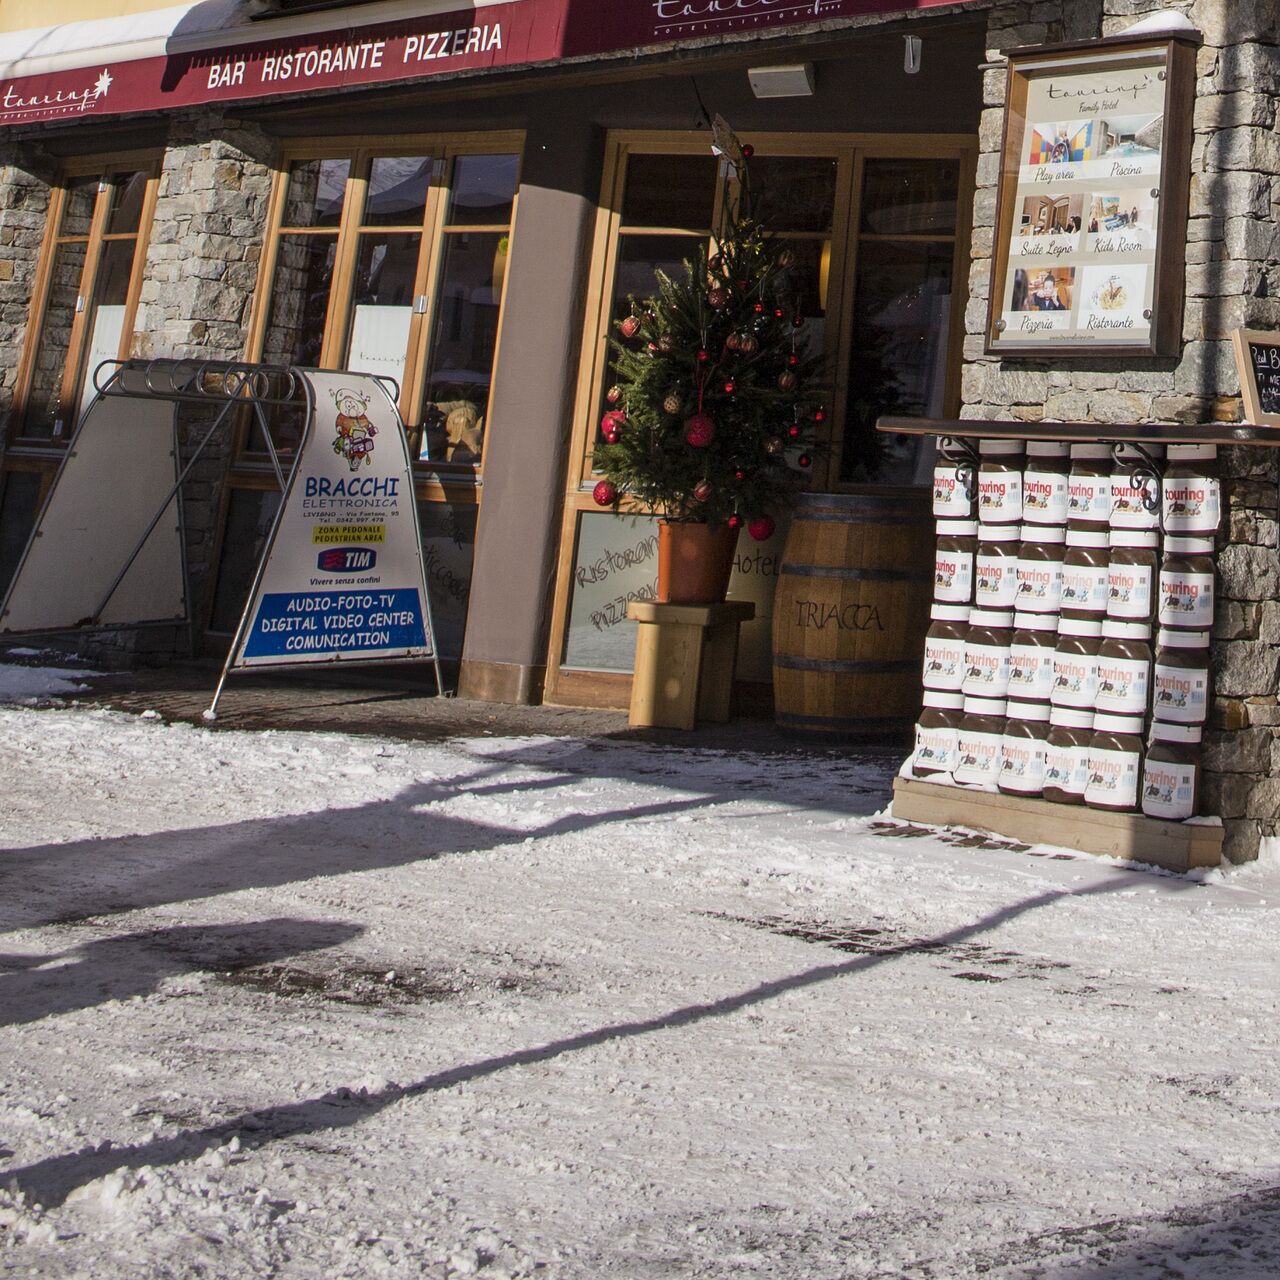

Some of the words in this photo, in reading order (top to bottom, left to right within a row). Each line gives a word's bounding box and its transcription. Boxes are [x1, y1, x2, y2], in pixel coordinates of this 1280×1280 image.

[207, 60, 245, 90] BAR
[261, 41, 386, 83] RISTORANTE
[403, 23, 502, 64] PIZZERIA
[1101, 99, 1119, 111] Hotel
[1034, 167, 1054, 184] Play
[1055, 171, 1074, 180] area
[1110, 161, 1143, 176] Piscina
[1021, 242, 1043, 256] Suite
[1094, 237, 1114, 253] Kids
[1117, 236, 1143, 251] Room
[1021, 314, 1054, 333] Pizzeria
[1087, 313, 1134, 330] Ristorante
[305, 477, 400, 497] BRACCHI
[1165, 486, 1205, 501] touring
[303, 498, 398, 508] ELETTRONICA
[318, 526, 339, 534] ZONA
[364, 534, 383, 542] AREA
[345, 551, 371, 568] TIM
[310, 578, 333, 586] Vivere
[356, 576, 381, 584] confini
[1017, 568, 1050, 584] touring
[1162, 581, 1199, 597] touring
[286, 594, 396, 613] AUDIO-FOTO-TV
[261, 616, 318, 633] DIGITAL
[323, 614, 364, 630] VIDEO
[368, 611, 415, 627] CENTER
[796, 600, 885, 631] TRIACCA
[286, 631, 391, 651] COMUNICATION
[926, 646, 960, 664] touring
[965, 651, 999, 670] touring
[1054, 661, 1086, 679] touring
[1097, 665, 1133, 684] touring
[1155, 674, 1191, 693] touring
[918, 732, 953, 751] touring
[958, 739, 996, 758] touring
[1001, 744, 1030, 763] touring
[1087, 757, 1122, 776] touring
